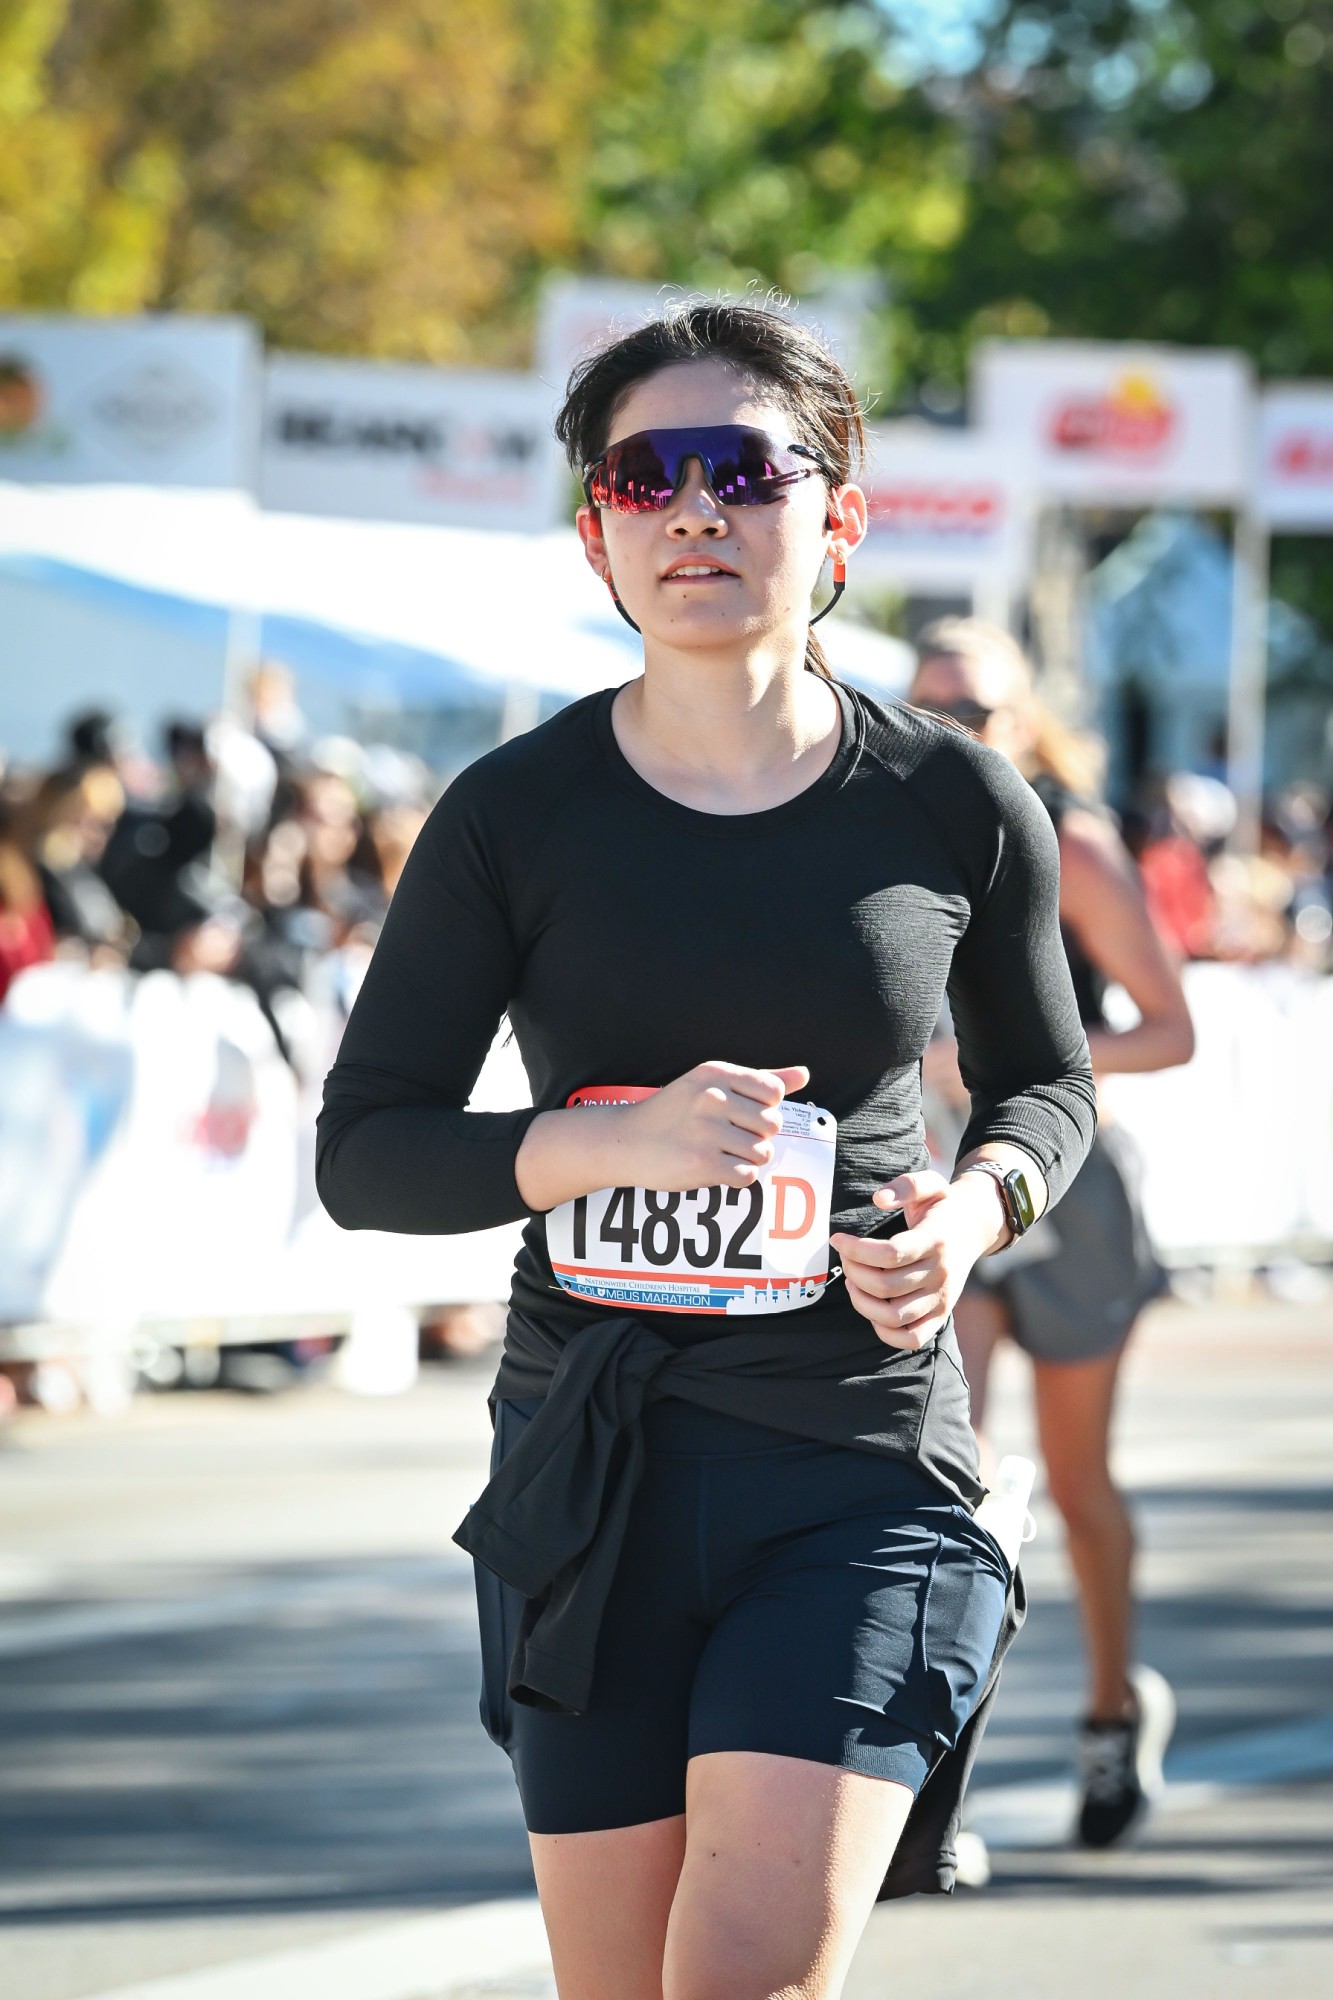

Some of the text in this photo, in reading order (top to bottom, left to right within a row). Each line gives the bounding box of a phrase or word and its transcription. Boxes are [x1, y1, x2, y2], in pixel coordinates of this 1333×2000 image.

[573, 1175, 816, 1270] 14832 D
[641, 1292, 711, 1306] MARATHON
